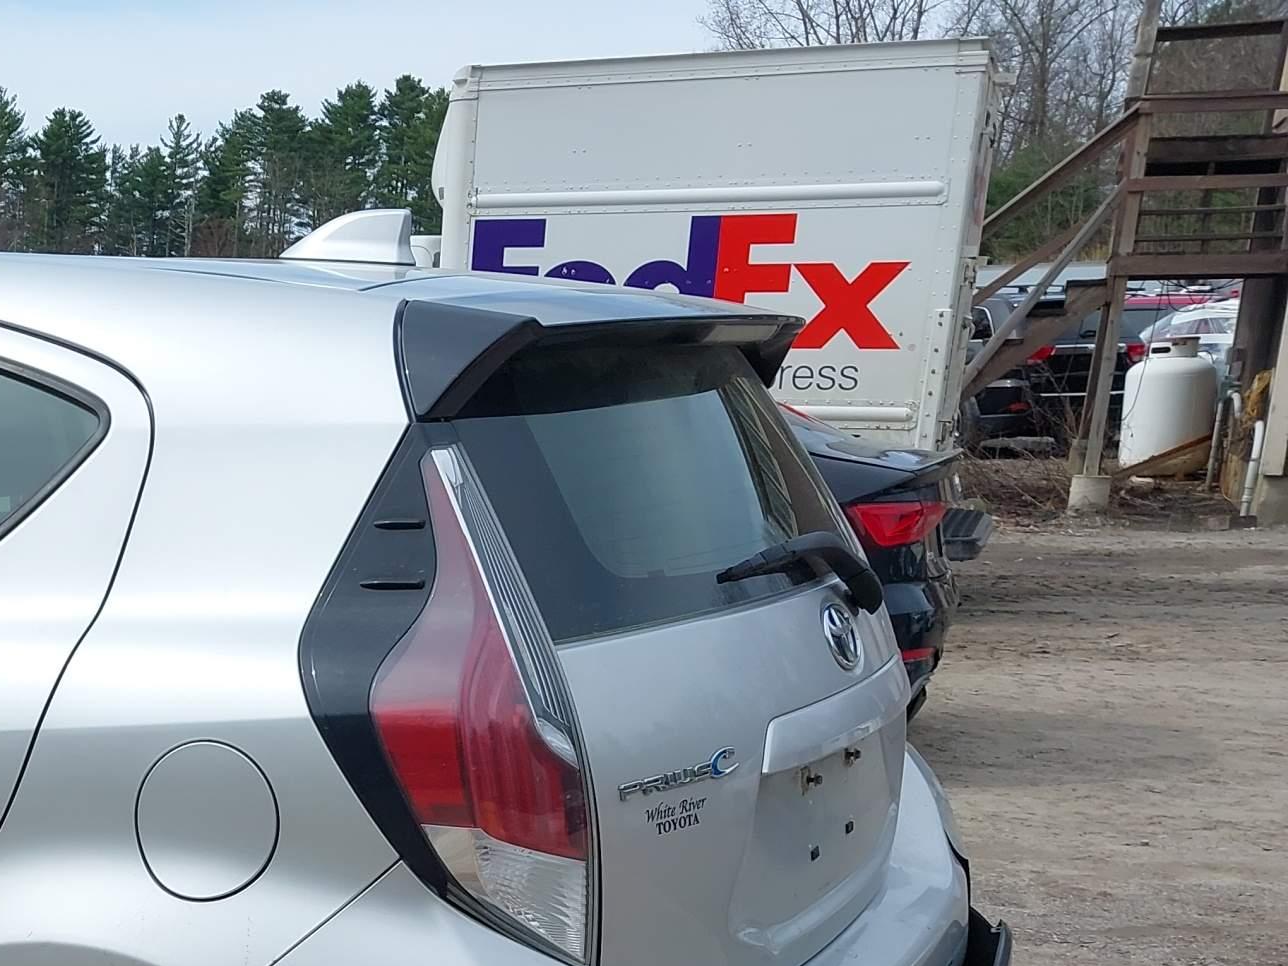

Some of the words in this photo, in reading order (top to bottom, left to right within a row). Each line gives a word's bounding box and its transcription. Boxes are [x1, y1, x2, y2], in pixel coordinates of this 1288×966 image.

[776, 364, 859, 390] ress
[645, 802, 676, 824] White
[679, 797, 707, 815] River
[655, 814, 700, 835] TOYOTA
